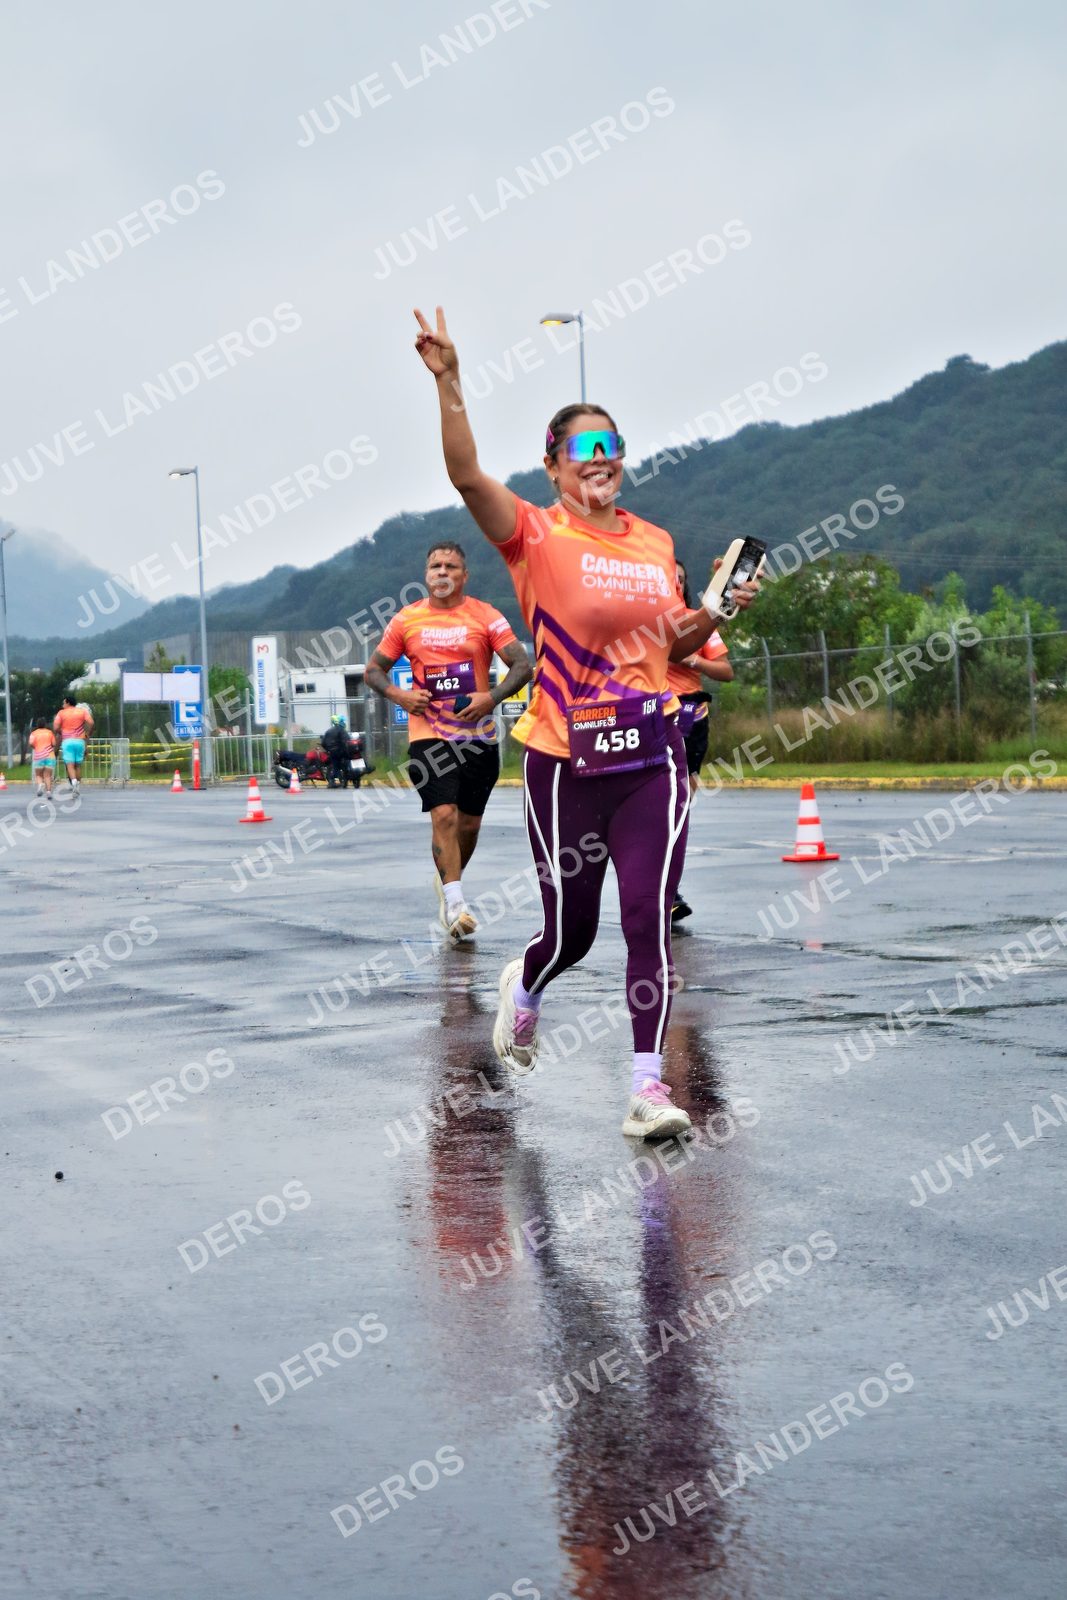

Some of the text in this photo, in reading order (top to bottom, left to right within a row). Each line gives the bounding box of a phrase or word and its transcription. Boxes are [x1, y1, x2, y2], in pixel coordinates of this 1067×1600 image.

[581, 552, 668, 583] CARRERA
[582, 574, 656, 594] OMNILIFE
[436, 678, 460, 691] 462
[573, 706, 616, 722] CARRERA
[573, 719, 608, 730] OMNILIFE
[594, 728, 640, 754] 458
